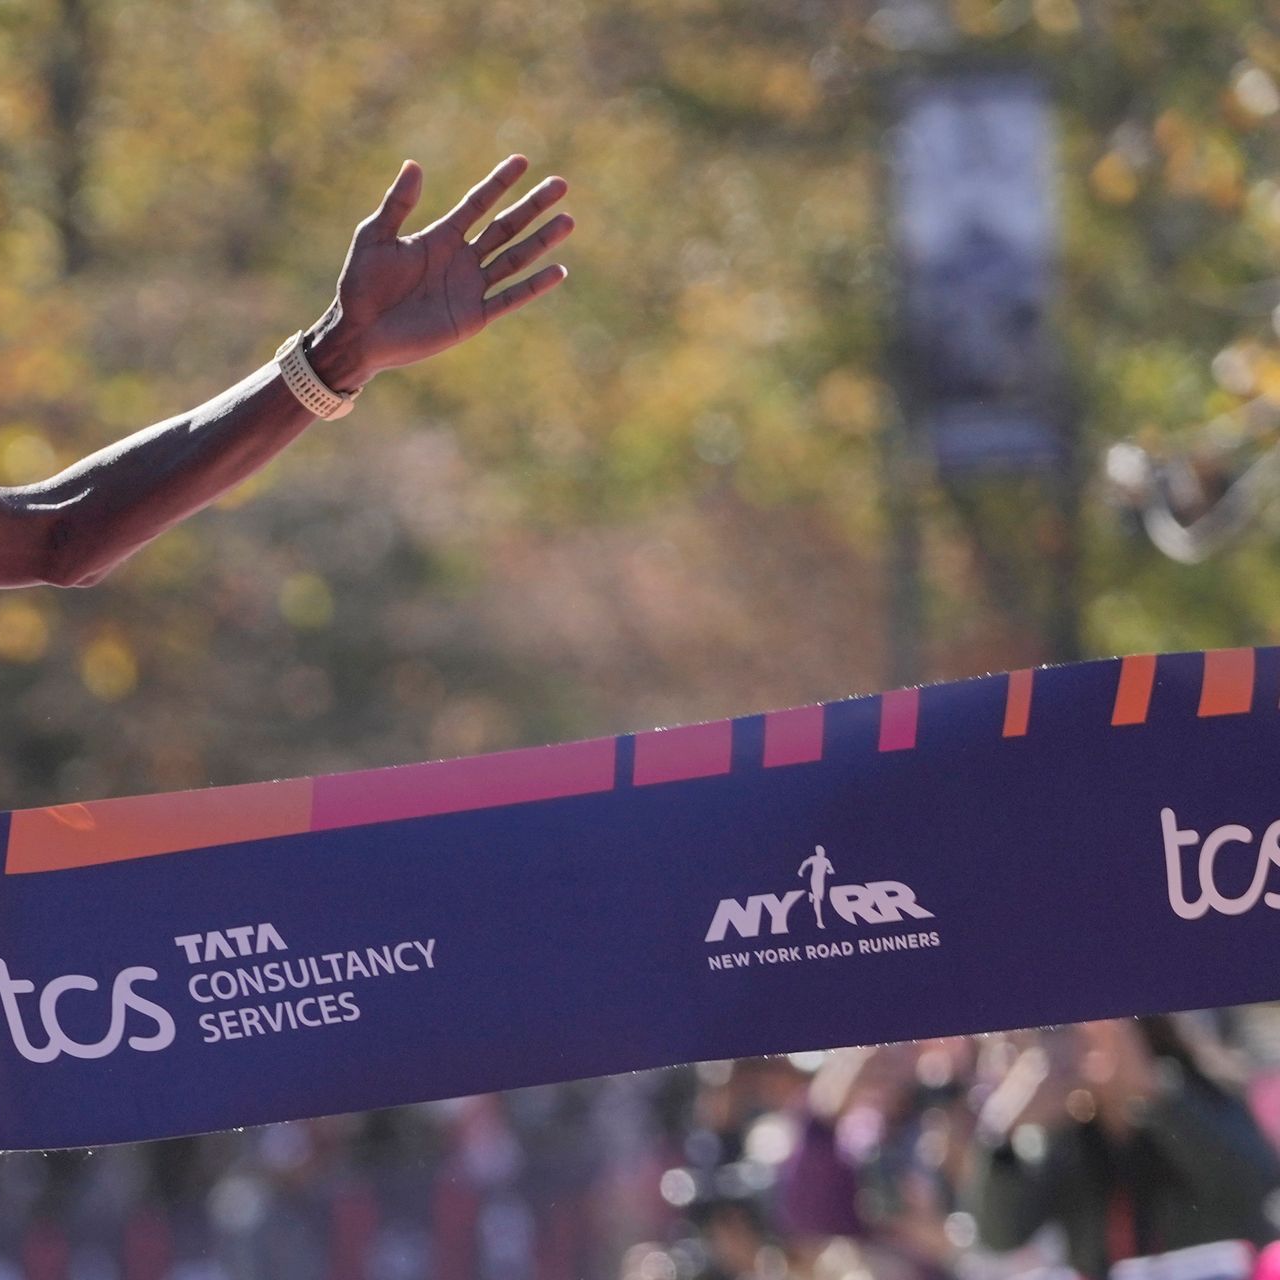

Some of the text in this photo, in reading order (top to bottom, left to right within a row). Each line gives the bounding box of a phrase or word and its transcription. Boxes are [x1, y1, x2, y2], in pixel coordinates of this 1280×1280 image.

[174, 922, 288, 964] TATA
[708, 931, 941, 971] NEW YORK ROAD RUNNERS
[187, 938, 437, 1003] CONSULTANCY
[198, 991, 361, 1044] SERVICES
